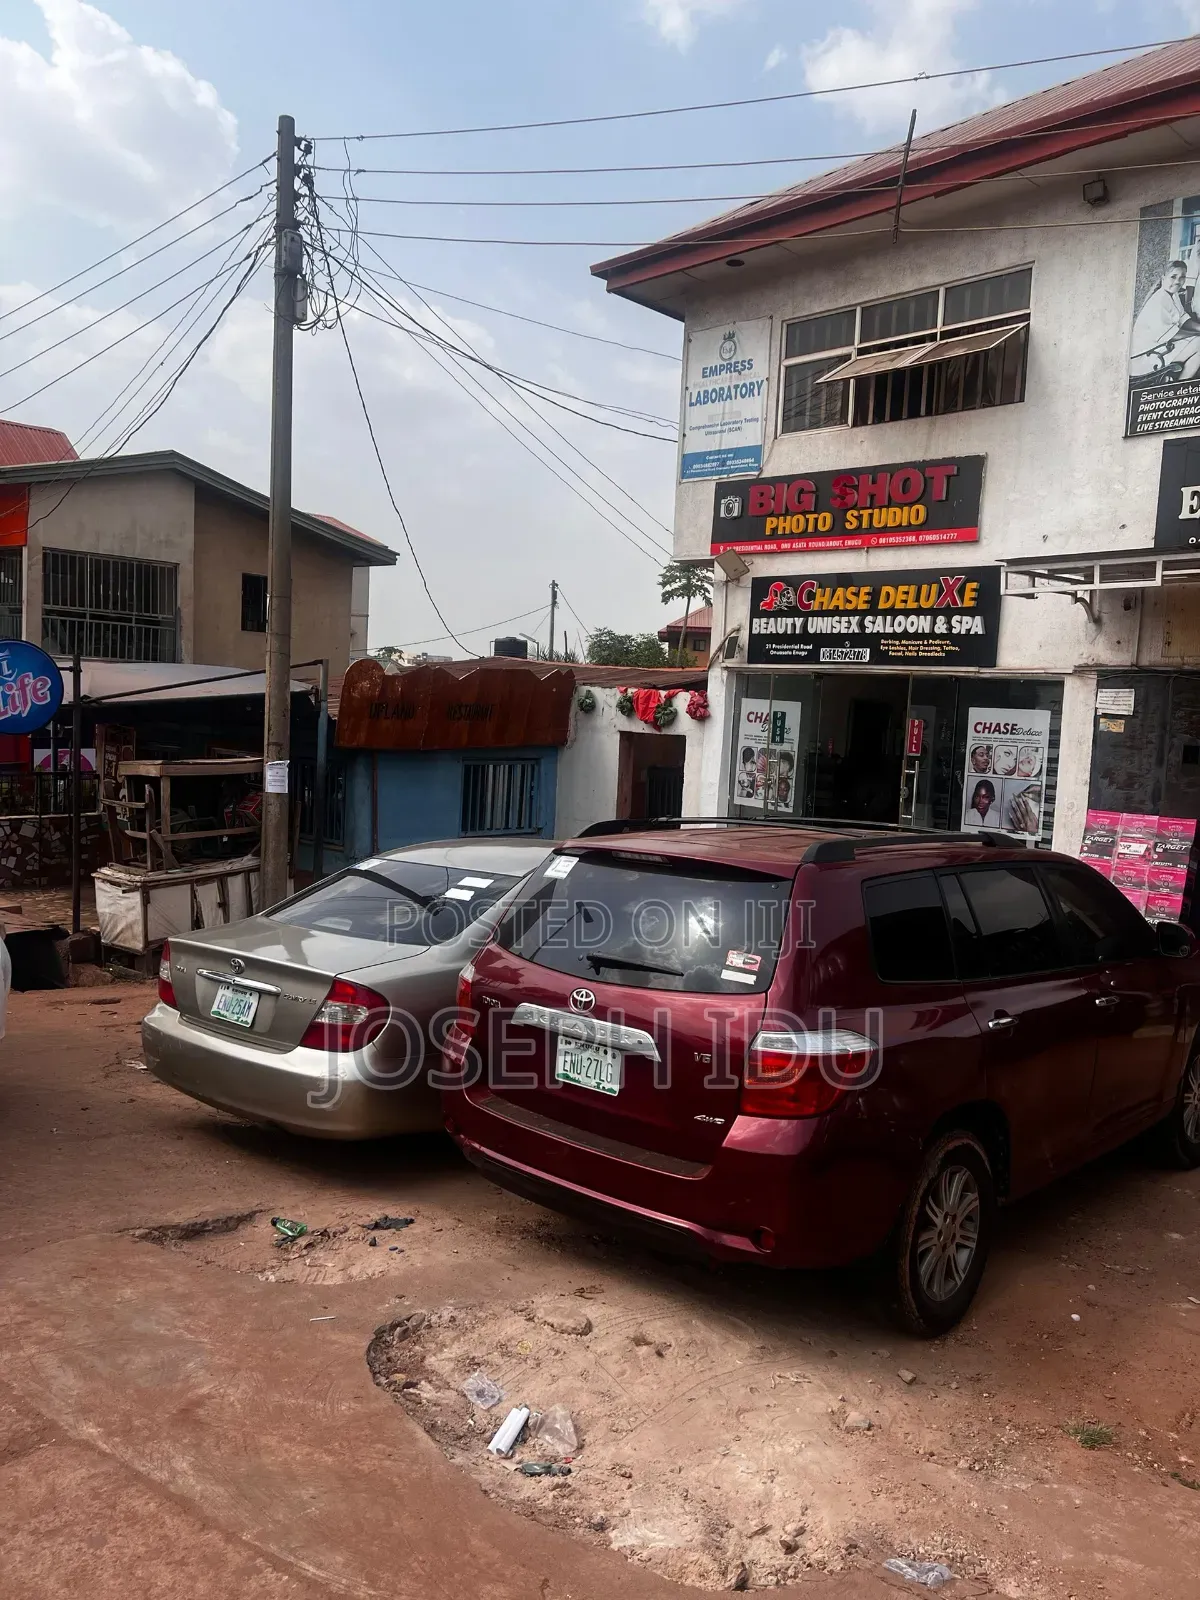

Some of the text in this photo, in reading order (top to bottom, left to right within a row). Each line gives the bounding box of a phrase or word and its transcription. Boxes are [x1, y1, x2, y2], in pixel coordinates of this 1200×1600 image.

[702, 358, 754, 379] EMPRESS
[689, 379, 764, 407] LABORATORY
[1140, 390, 1174, 401] Service
[1138, 395, 1200, 412] PHOTOGRAPHY
[1137, 411, 1163, 422] EVENT
[1136, 422, 1154, 432] LIVE
[748, 465, 960, 517] BIG SHOT
[765, 504, 927, 536] PHOTO STUDIO
[797, 575, 981, 612] CHASE DELUXE
[751, 615, 985, 635] BEAUTY UNISEX SALOON & SPA
[911, 719, 919, 752] PULL
[973, 721, 1018, 736] CHASE
[1084, 835, 1115, 844] TARGET
[1155, 842, 1188, 852] TARGET
[693, 1051, 712, 1064] V6
[562, 1050, 614, 1084] ENU-27LG
